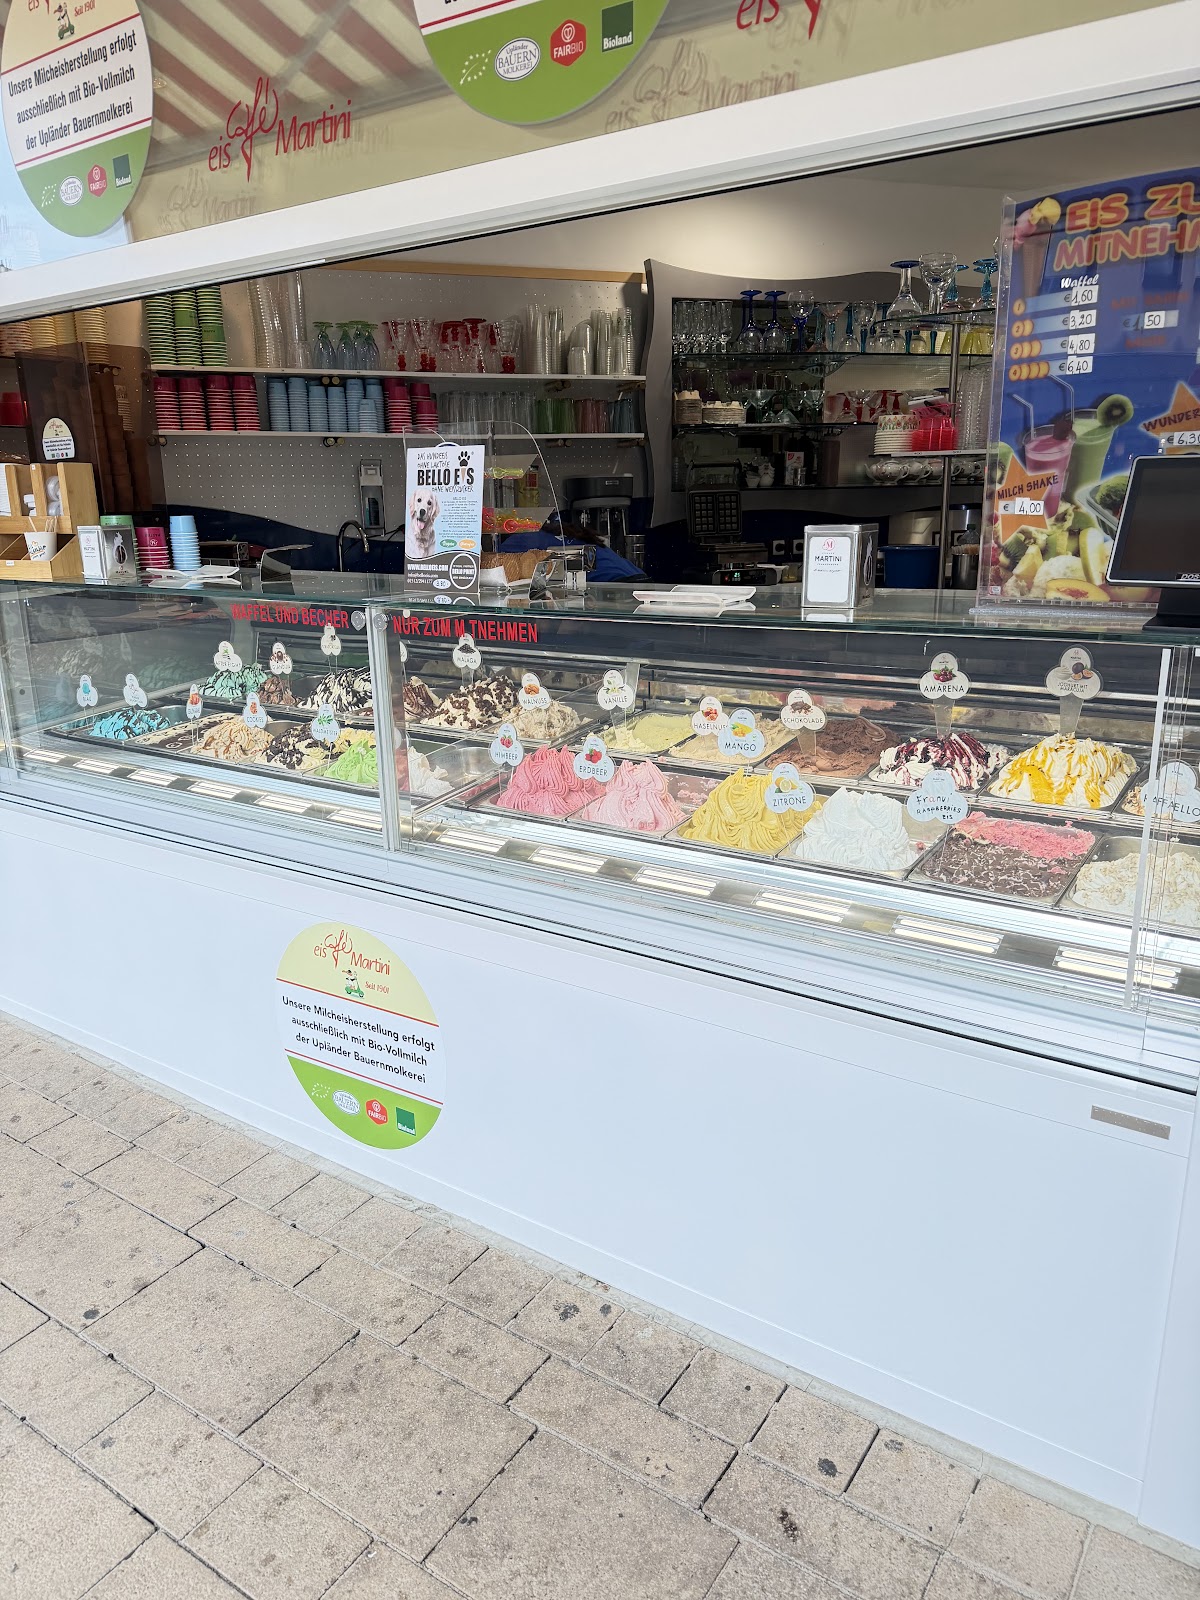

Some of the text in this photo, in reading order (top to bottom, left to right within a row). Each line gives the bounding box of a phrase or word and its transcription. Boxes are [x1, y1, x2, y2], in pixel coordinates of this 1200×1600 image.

[506, 43, 528, 55] Upländer
[603, 31, 632, 49] Bioland
[498, 48, 537, 69] BAUERN
[553, 41, 584, 59] FAIRBIO
[8, 29, 137, 97] Unsere Milcheisherstellung erfolgt
[503, 61, 533, 76] MOLKEREI
[16, 64, 135, 124] ausschließlich mit Bio-Vollmilch
[25, 97, 133, 150] der Upländer Bauernmolkerei
[208, 135, 231, 172] eis
[275, 99, 352, 156] Martini
[90, 180, 107, 192] FAIRBIO
[115, 175, 132, 187] Bioland
[1065, 193, 1129, 235] EIS
[1060, 274, 1099, 289] Waffel
[417, 468, 451, 486] BELLO
[997, 475, 1059, 500] MILCH SHAKE
[230, 604, 349, 628] WAFFEL UND BECHER
[393, 615, 420, 635] NUR
[423, 617, 451, 637] ZUM
[923, 685, 965, 693] AMARENA
[522, 697, 548, 705] WALNUSS
[603, 696, 628, 704] VANILLE
[247, 716, 264, 724] COOKIES
[724, 742, 757, 752] MANGO
[494, 752, 518, 761] HIMBEER
[579, 765, 608, 777] ERDBEER
[773, 796, 807, 807] ZITRONE
[313, 943, 327, 958] eis
[350, 951, 390, 975] Martini
[365, 981, 376, 990] Seit
[282, 995, 435, 1052] Unsere Milcheisherstellung erfolgt
[291, 1017, 427, 1066] ausschließlich mit Bio-Vollmilch
[295, 1032, 426, 1083] der Upländer Bauernmolkerei
[397, 1122, 416, 1135] Bioland
